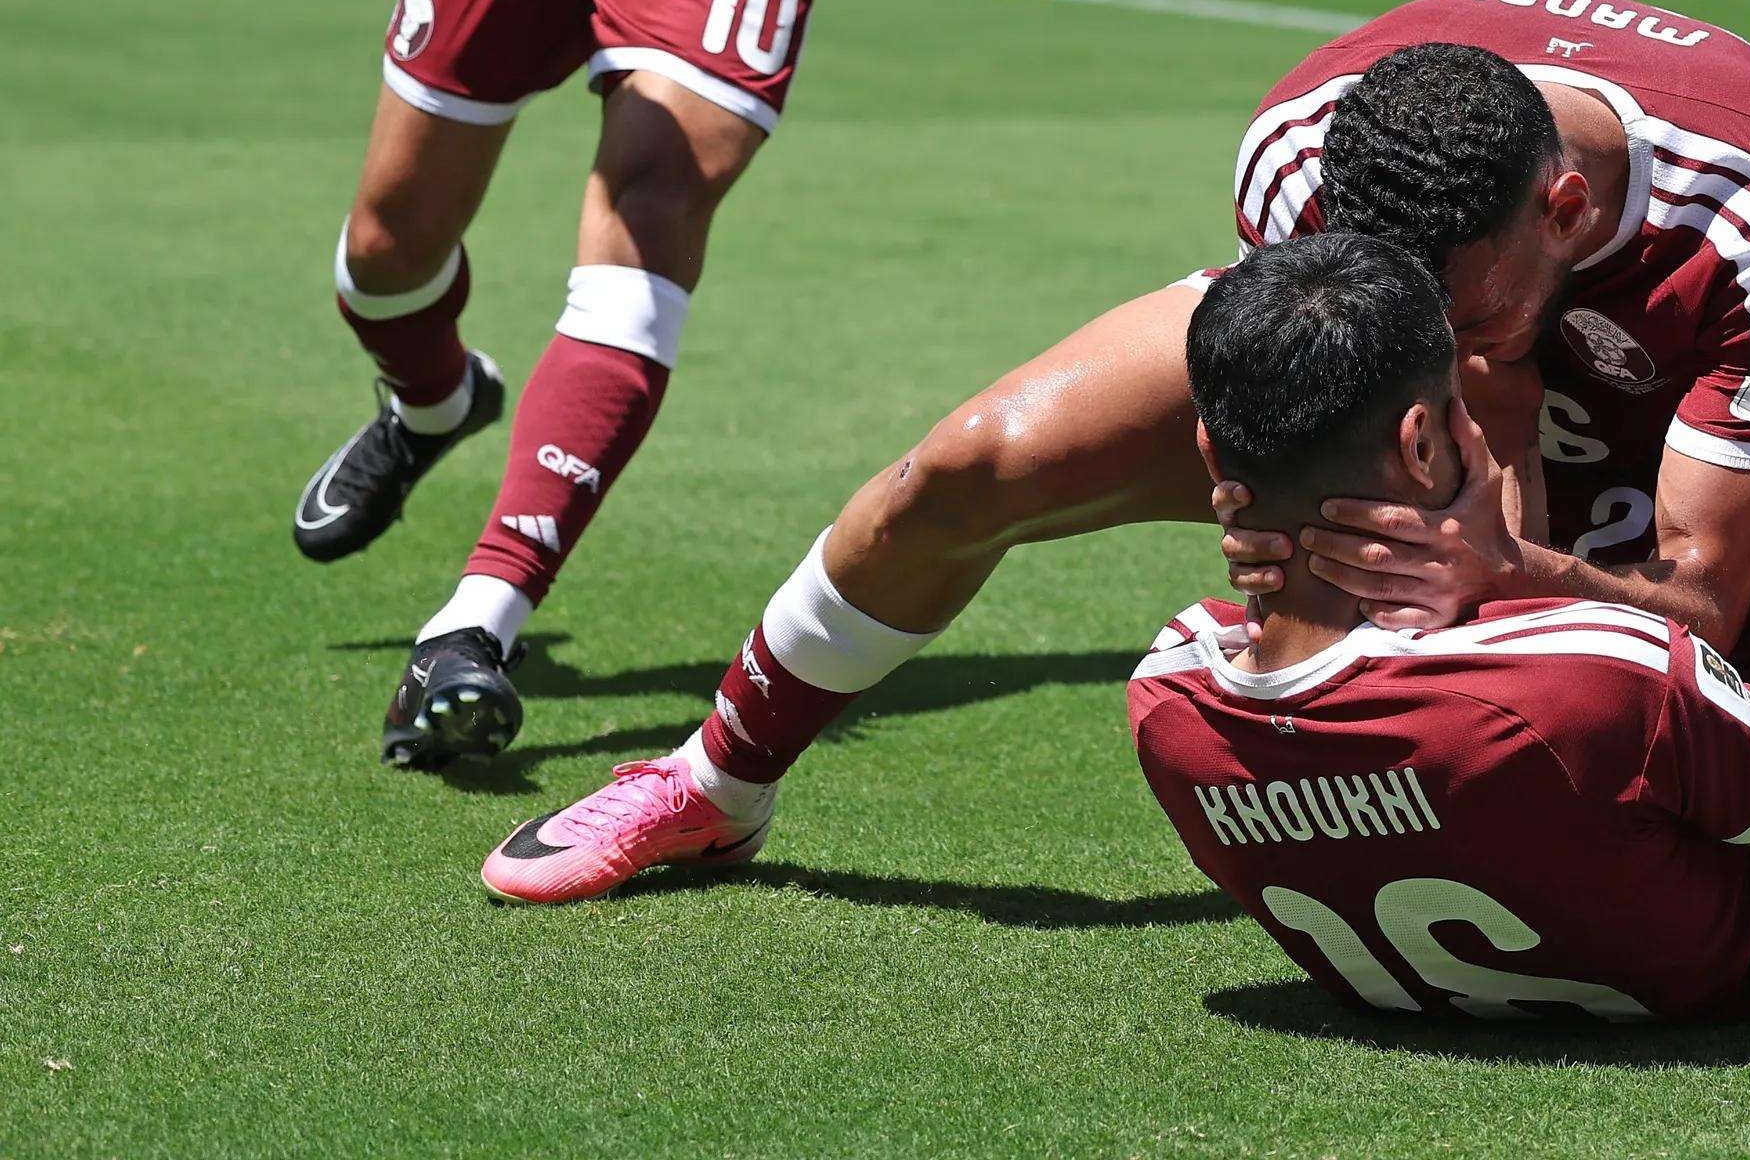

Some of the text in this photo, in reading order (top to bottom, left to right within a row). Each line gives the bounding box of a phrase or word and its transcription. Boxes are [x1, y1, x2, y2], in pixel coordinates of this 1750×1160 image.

[537, 443, 601, 495] QFA
[1194, 766, 1441, 846] KHOUKHI
[1261, 877, 1656, 1022] 16
